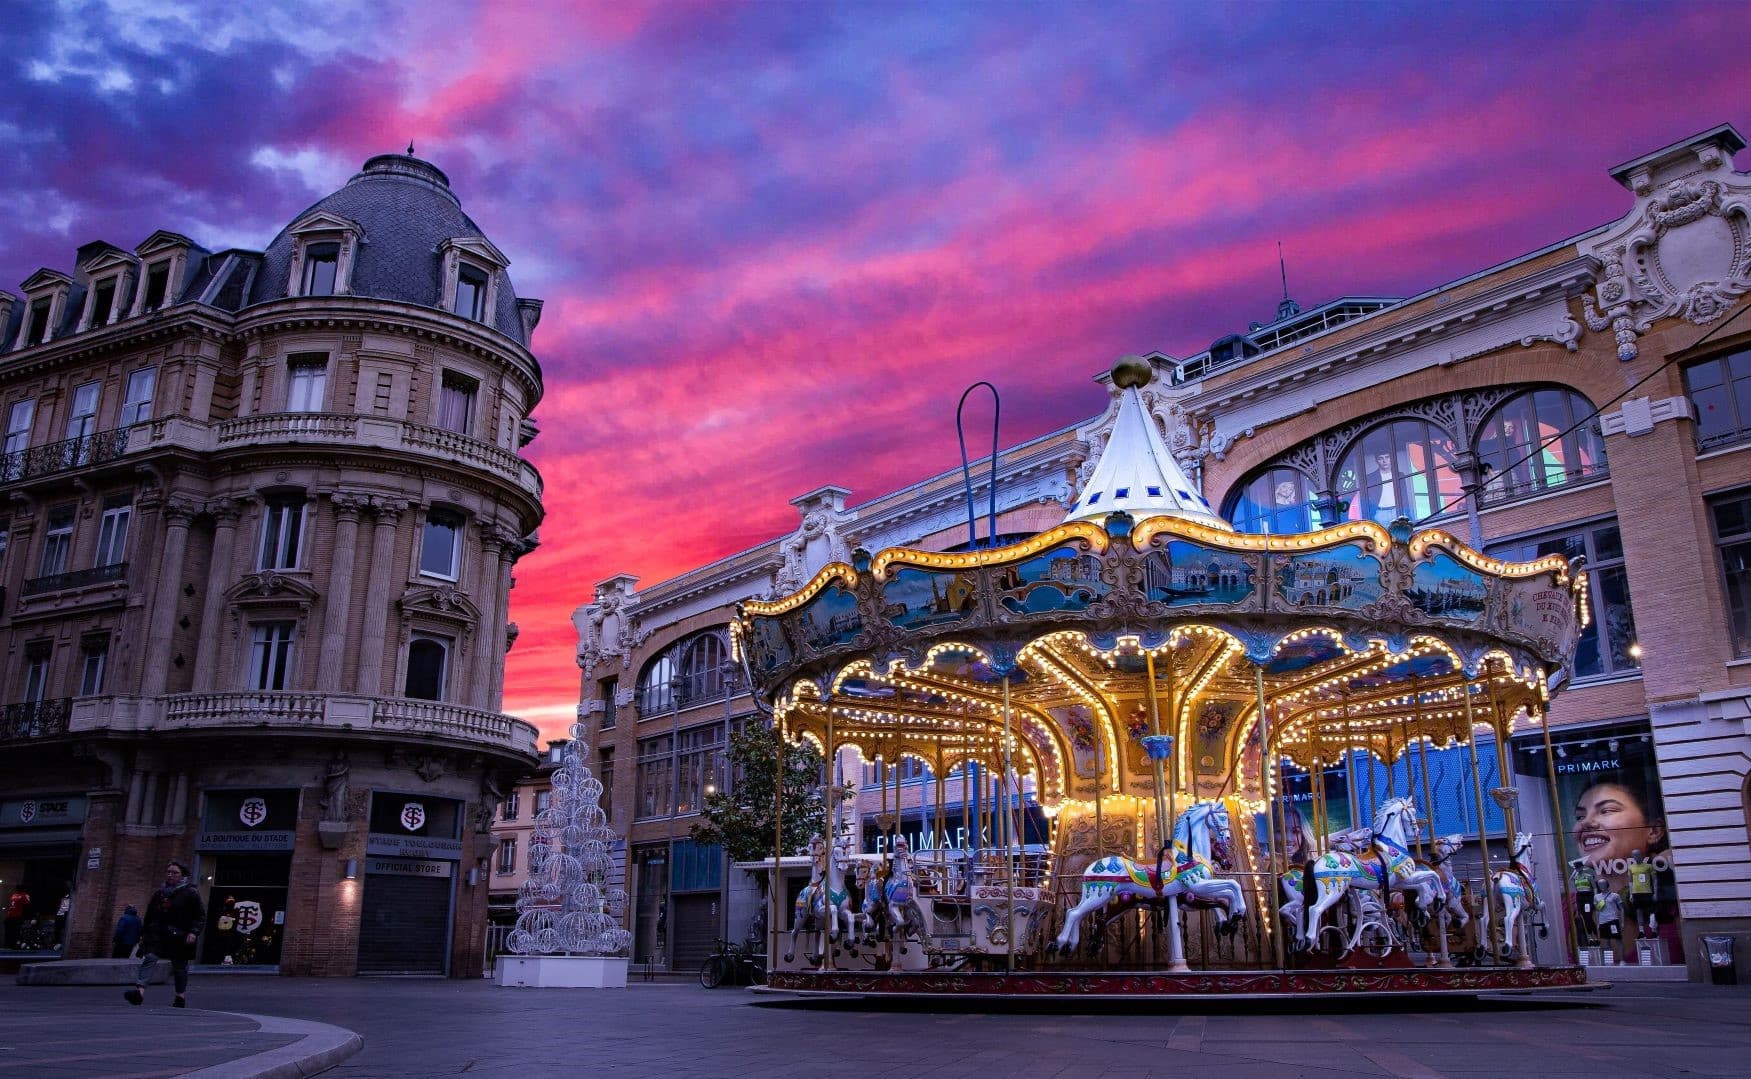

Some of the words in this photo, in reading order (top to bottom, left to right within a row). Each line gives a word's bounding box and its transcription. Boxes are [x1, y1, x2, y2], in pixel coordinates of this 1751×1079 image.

[1558, 759, 1620, 774] PRIMARK
[201, 834, 211, 842] LA
[213, 834, 249, 842] BOUTIQUE
[251, 834, 262, 842] DU
[264, 834, 289, 842] STADE
[375, 862, 413, 872] OFFICIAL
[415, 864, 441, 874] STORE
